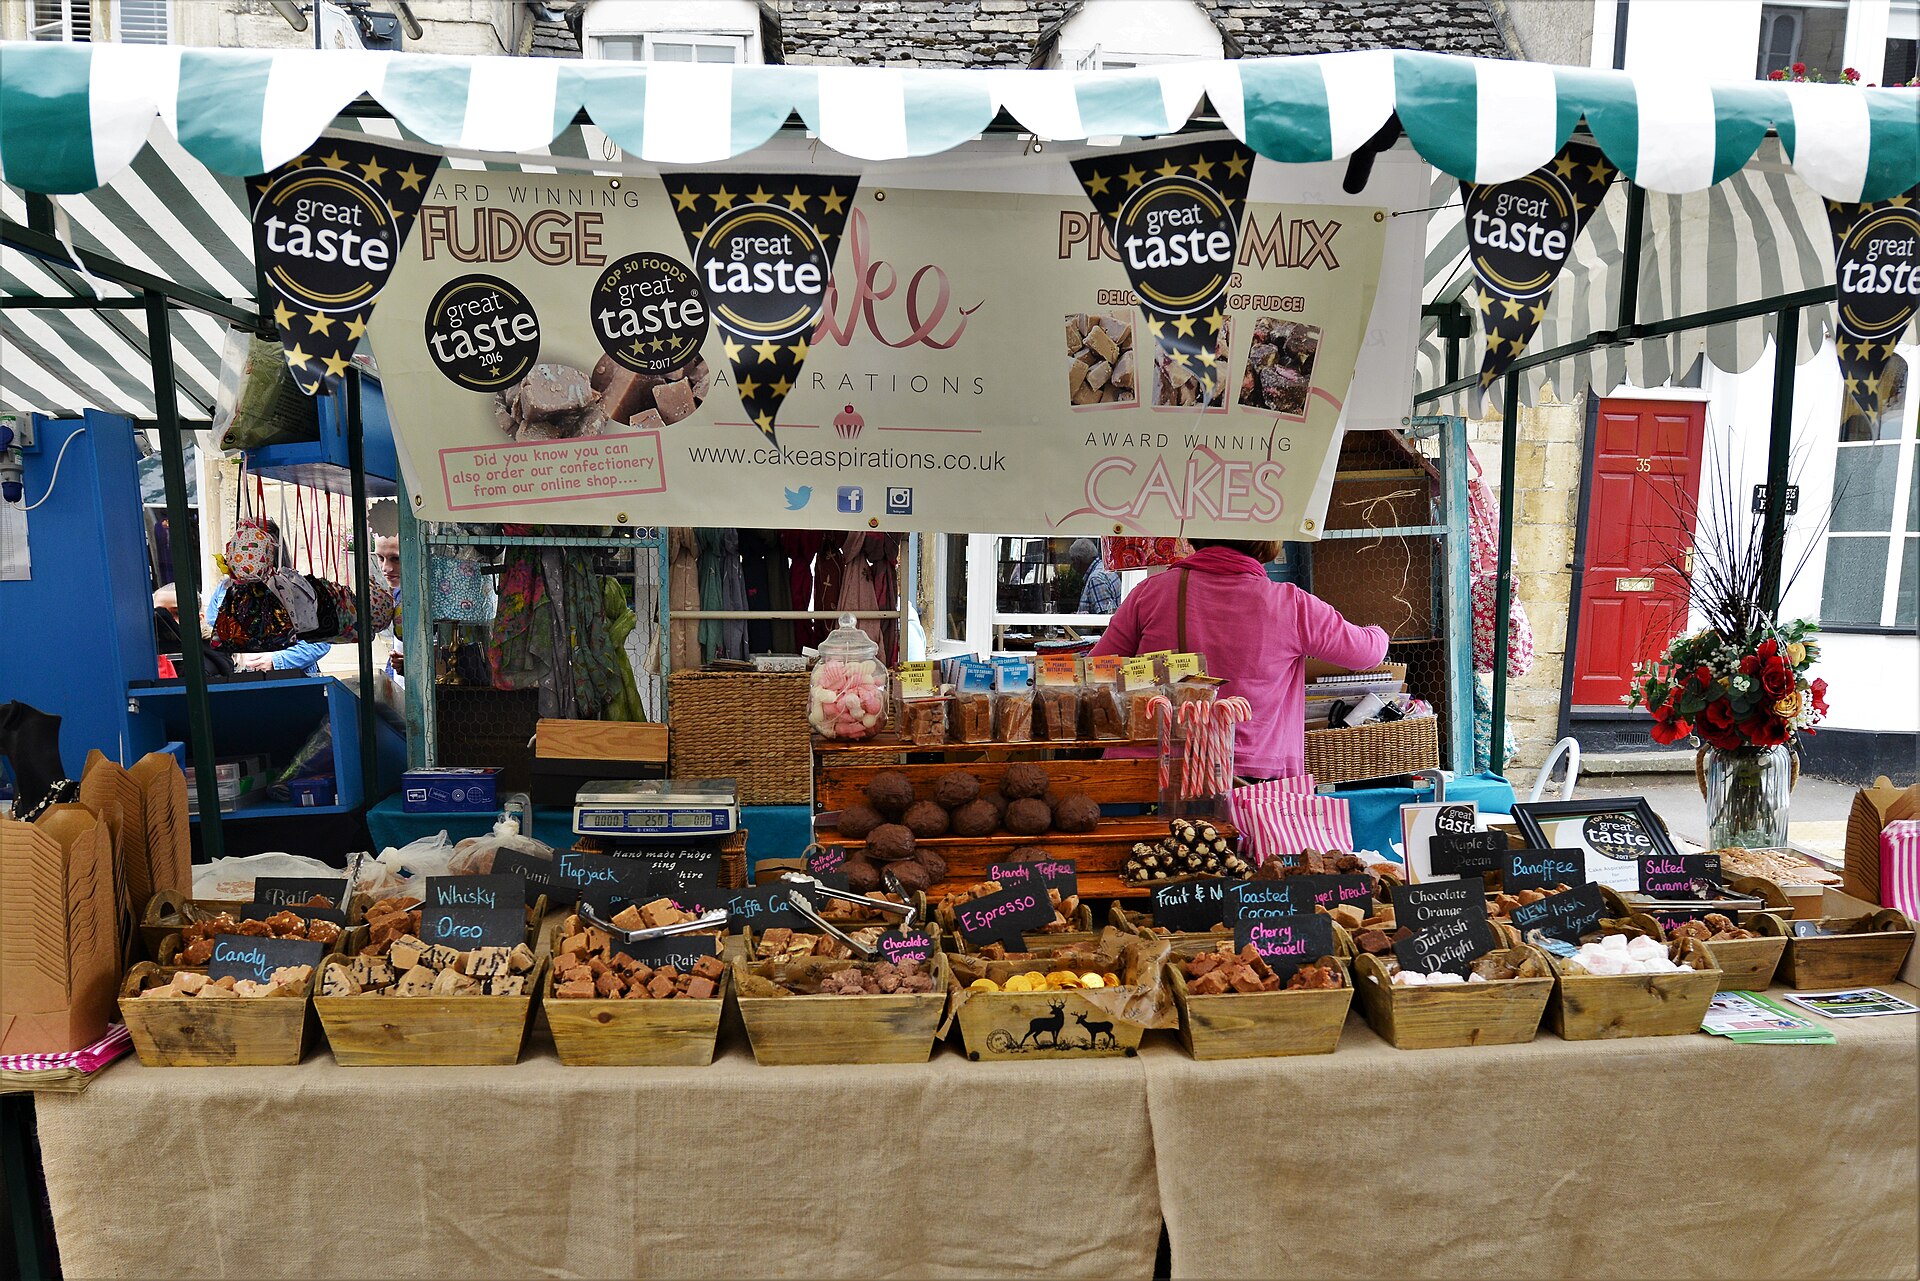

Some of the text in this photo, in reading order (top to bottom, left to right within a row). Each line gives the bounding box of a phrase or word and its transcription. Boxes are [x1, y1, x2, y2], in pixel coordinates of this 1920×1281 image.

[433, 183, 640, 208] ARD WINNING
[1495, 193, 1549, 219] great
[295, 199, 362, 227] great
[1147, 203, 1203, 235] great
[264, 215, 389, 272] taste
[420, 205, 608, 267] FUDGE
[731, 234, 792, 260] great
[1058, 210, 1343, 271] PIC MIX
[1472, 209, 1567, 261] taste
[1124, 229, 1231, 270] taste
[1866, 236, 1915, 262] great
[600, 258, 688, 294] TOP 50 FOODS
[704, 256, 822, 296] taste
[1842, 259, 1920, 295] taste
[618, 275, 675, 307] great
[447, 291, 504, 328] great
[1229, 296, 1252, 310] OF
[1251, 296, 1305, 312] FUDGE!
[597, 298, 704, 339] taste
[430, 311, 538, 363] taste
[478, 352, 504, 367] 2016
[650, 358, 671, 371] 2017
[1085, 431, 1292, 453] AWARD WINNING
[473, 444, 629, 468] Did you know you can
[688, 445, 1007, 472] www.cakeaspirations.co.uk
[1636, 458, 1651, 472] 35
[452, 457, 655, 484] also order our confectionery
[474, 474, 638, 497] from our online shop....
[1084, 454, 1286, 522] CAKES
[1449, 809, 1472, 820] great
[1600, 822, 1633, 832] great
[1440, 835, 1497, 853] Maple &
[1587, 828, 1650, 847] taste
[613, 850, 712, 860] Hand made Fudge
[652, 861, 676, 871] sing
[810, 849, 835, 868] Salted
[1645, 857, 1686, 874] Salted
[560, 854, 619, 885] Flapjack
[991, 862, 1074, 880] Brandy Toffee
[1512, 856, 1579, 881] Banoffee
[1156, 885, 1189, 908] Fruit
[1194, 884, 1205, 902] &
[1230, 882, 1289, 904] Toasted
[1339, 883, 1371, 899] bread
[1409, 889, 1467, 905] Chocolate
[1646, 877, 1694, 892] Caramel
[437, 886, 496, 909] Whisky
[728, 896, 789, 916] Jaffa Ca
[1515, 897, 1586, 923] NEW Irish
[961, 895, 1035, 932] Espresso
[437, 916, 483, 939] Oreo
[1250, 923, 1292, 944] Cherry
[1413, 919, 1469, 955] Turkish
[882, 935, 930, 950] Chocolate
[1252, 939, 1306, 956] Bakewell
[215, 942, 266, 976] Candy
[1421, 939, 1475, 972] Delight
